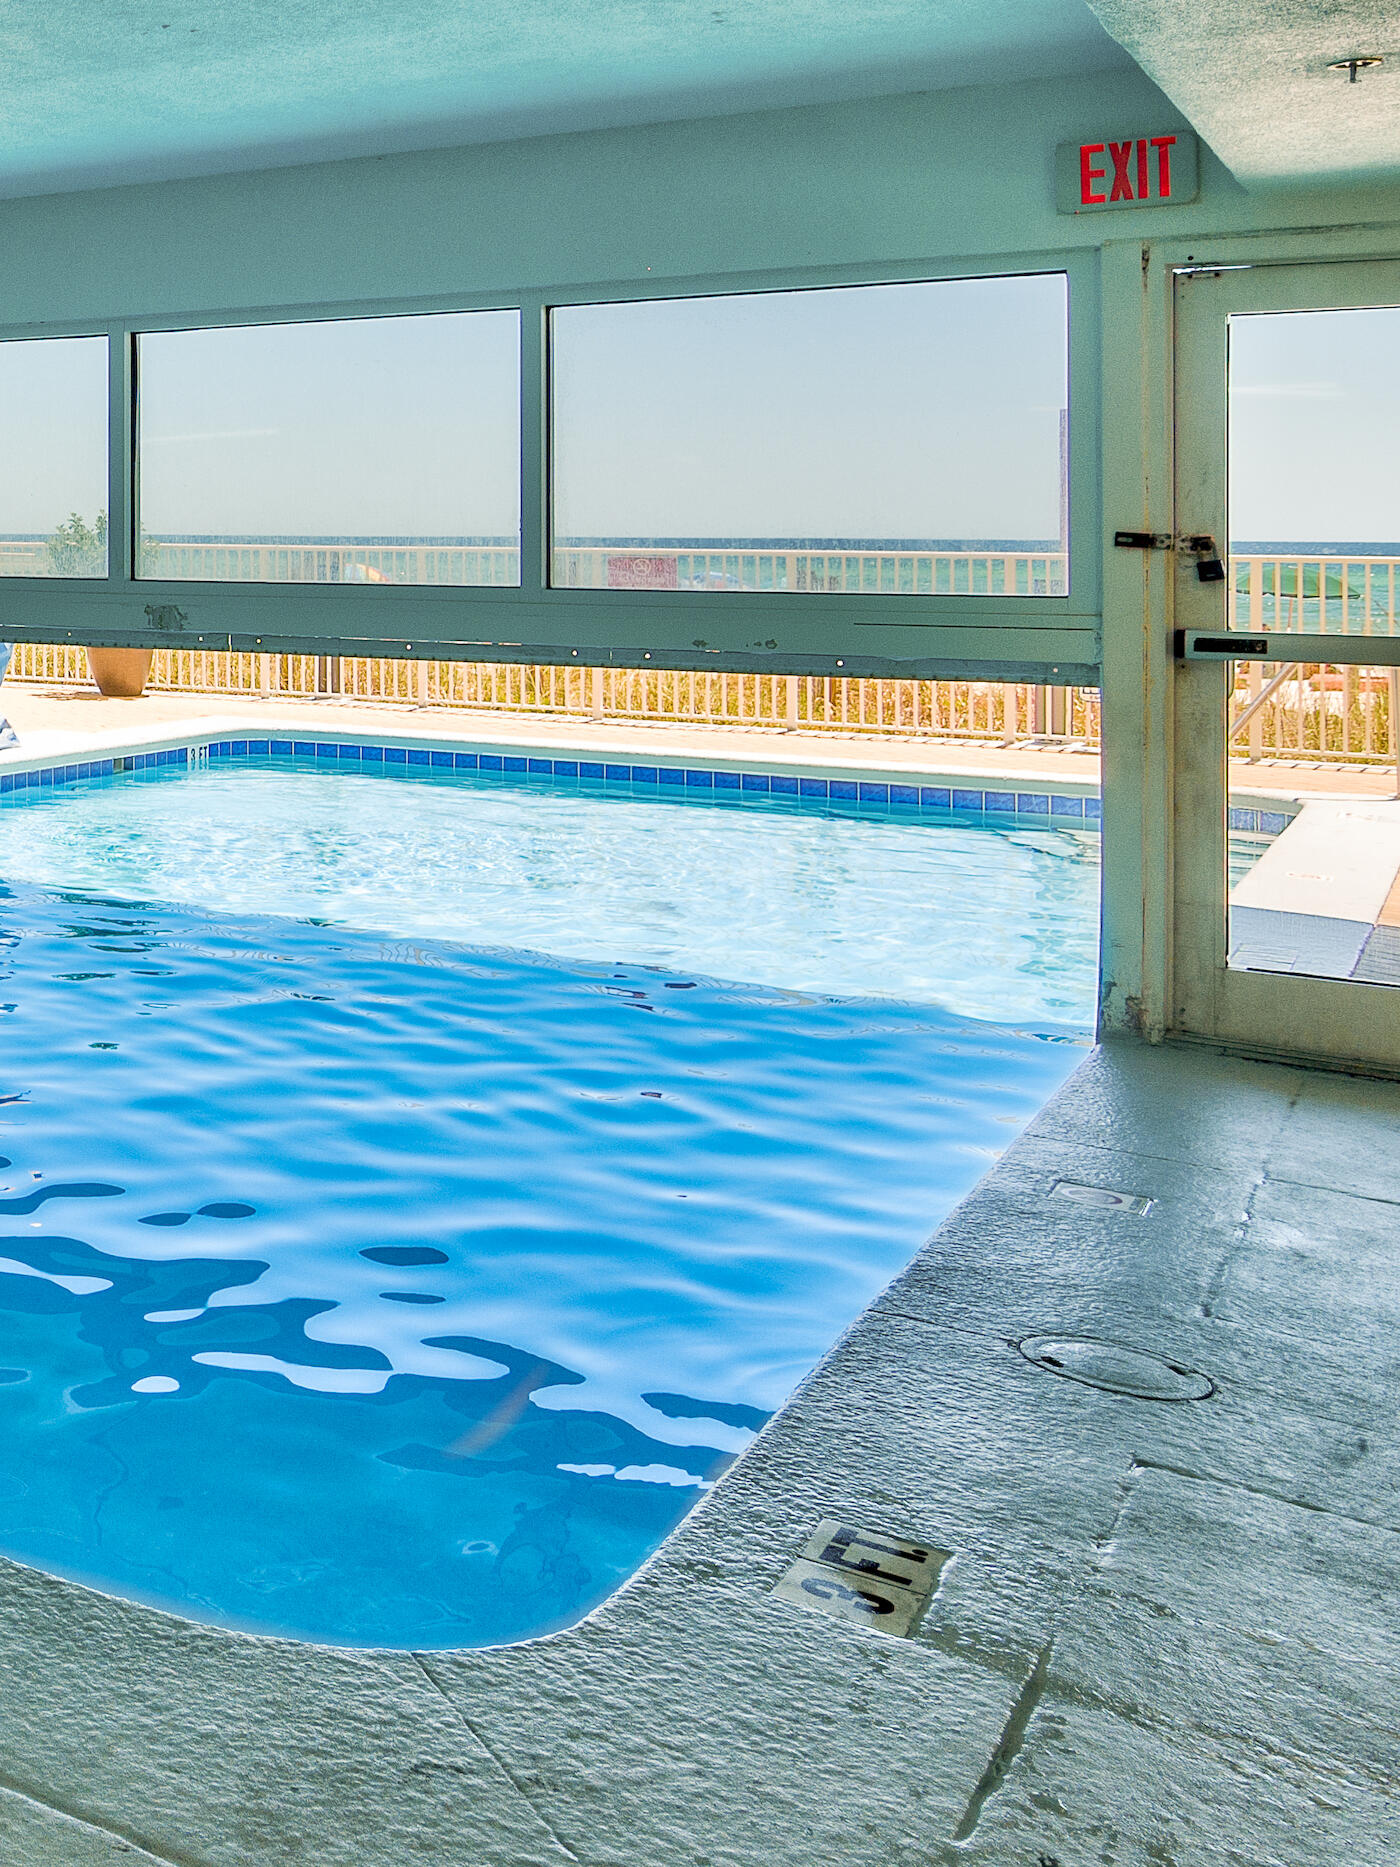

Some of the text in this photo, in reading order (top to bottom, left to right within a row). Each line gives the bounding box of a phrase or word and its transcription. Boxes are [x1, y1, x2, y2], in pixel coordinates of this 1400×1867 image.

[1080, 136, 1177, 205] EXIT
[190, 748, 196, 760] 3
[800, 1577, 895, 1615] 3
